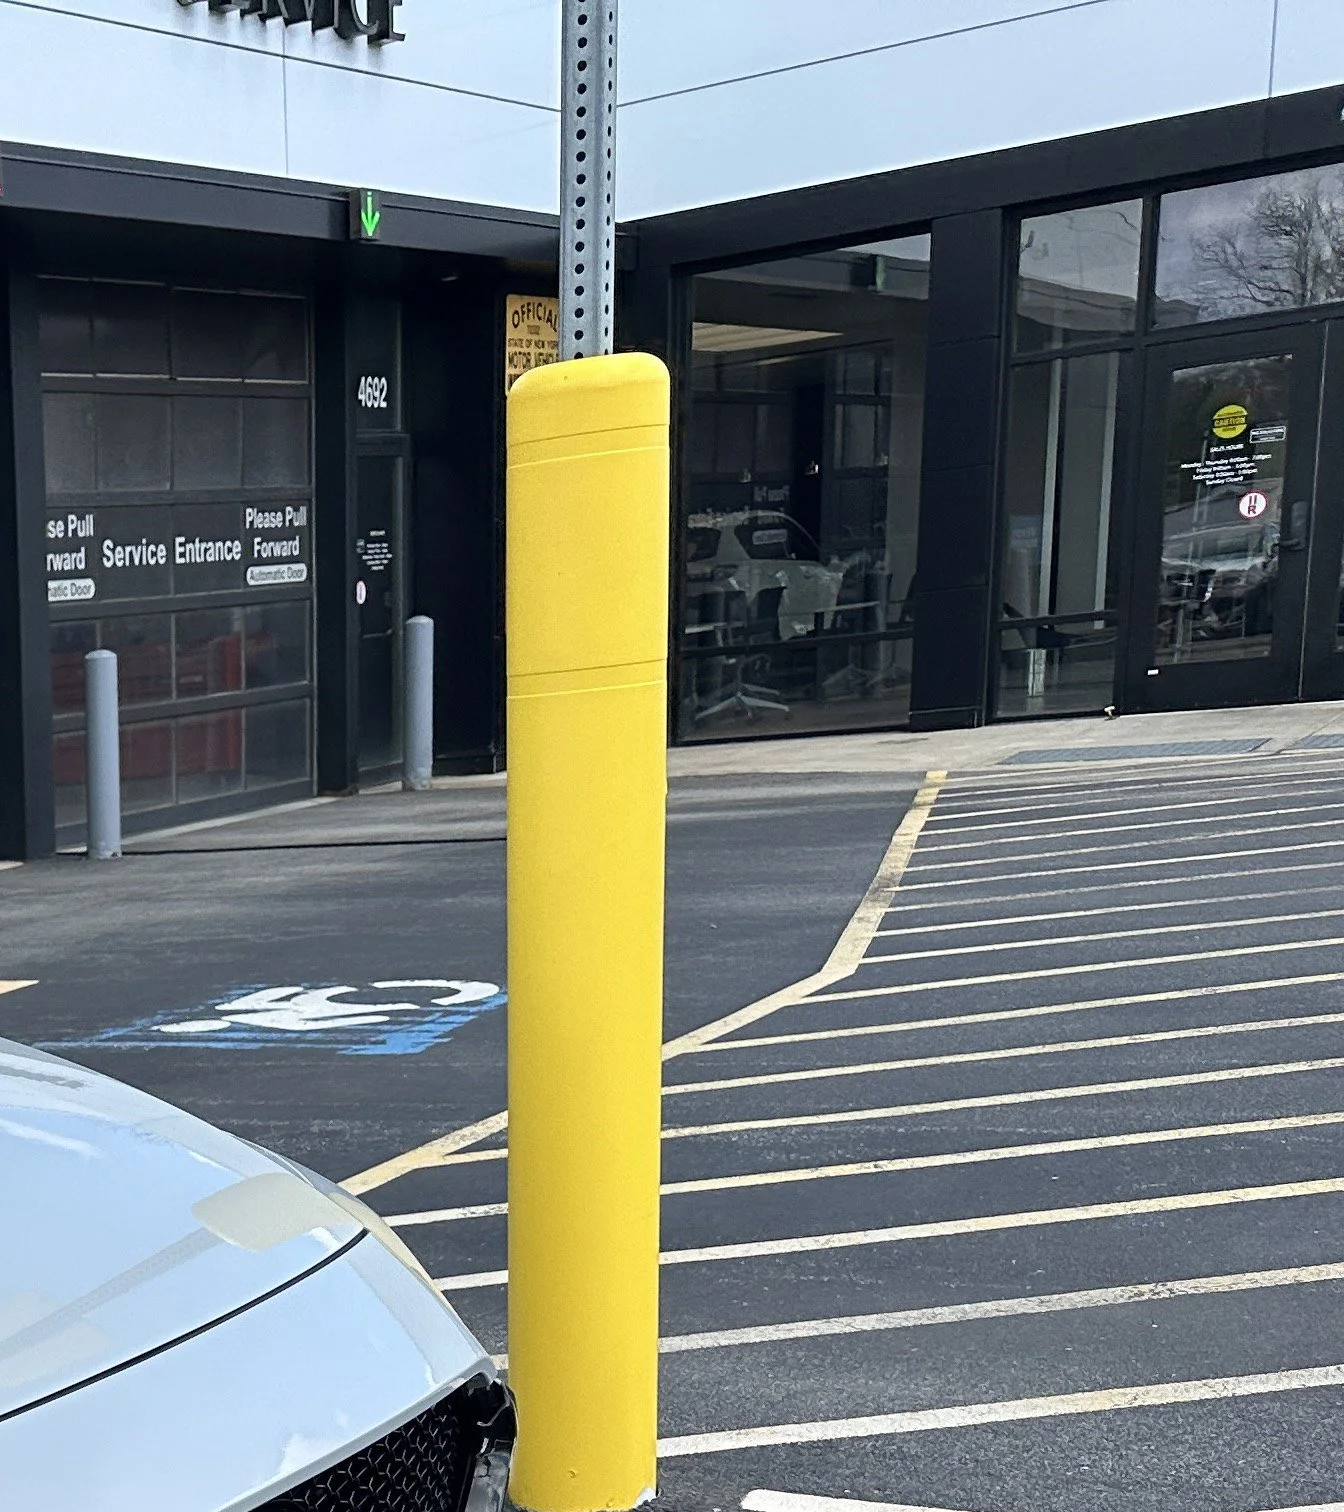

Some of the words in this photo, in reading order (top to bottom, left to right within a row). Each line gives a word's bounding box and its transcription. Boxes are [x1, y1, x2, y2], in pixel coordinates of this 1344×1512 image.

[512, 302, 558, 333] OFFICIAL
[358, 376, 387, 408] 4692
[67, 514, 94, 537] Pull
[245, 507, 283, 530] Please
[285, 505, 307, 528] Pull
[102, 538, 168, 569] Service
[174, 536, 242, 565] Entrance
[253, 535, 300, 559] Forward
[249, 566, 285, 583] Automatic
[287, 565, 305, 579] Door
[70, 582, 92, 597] Door
